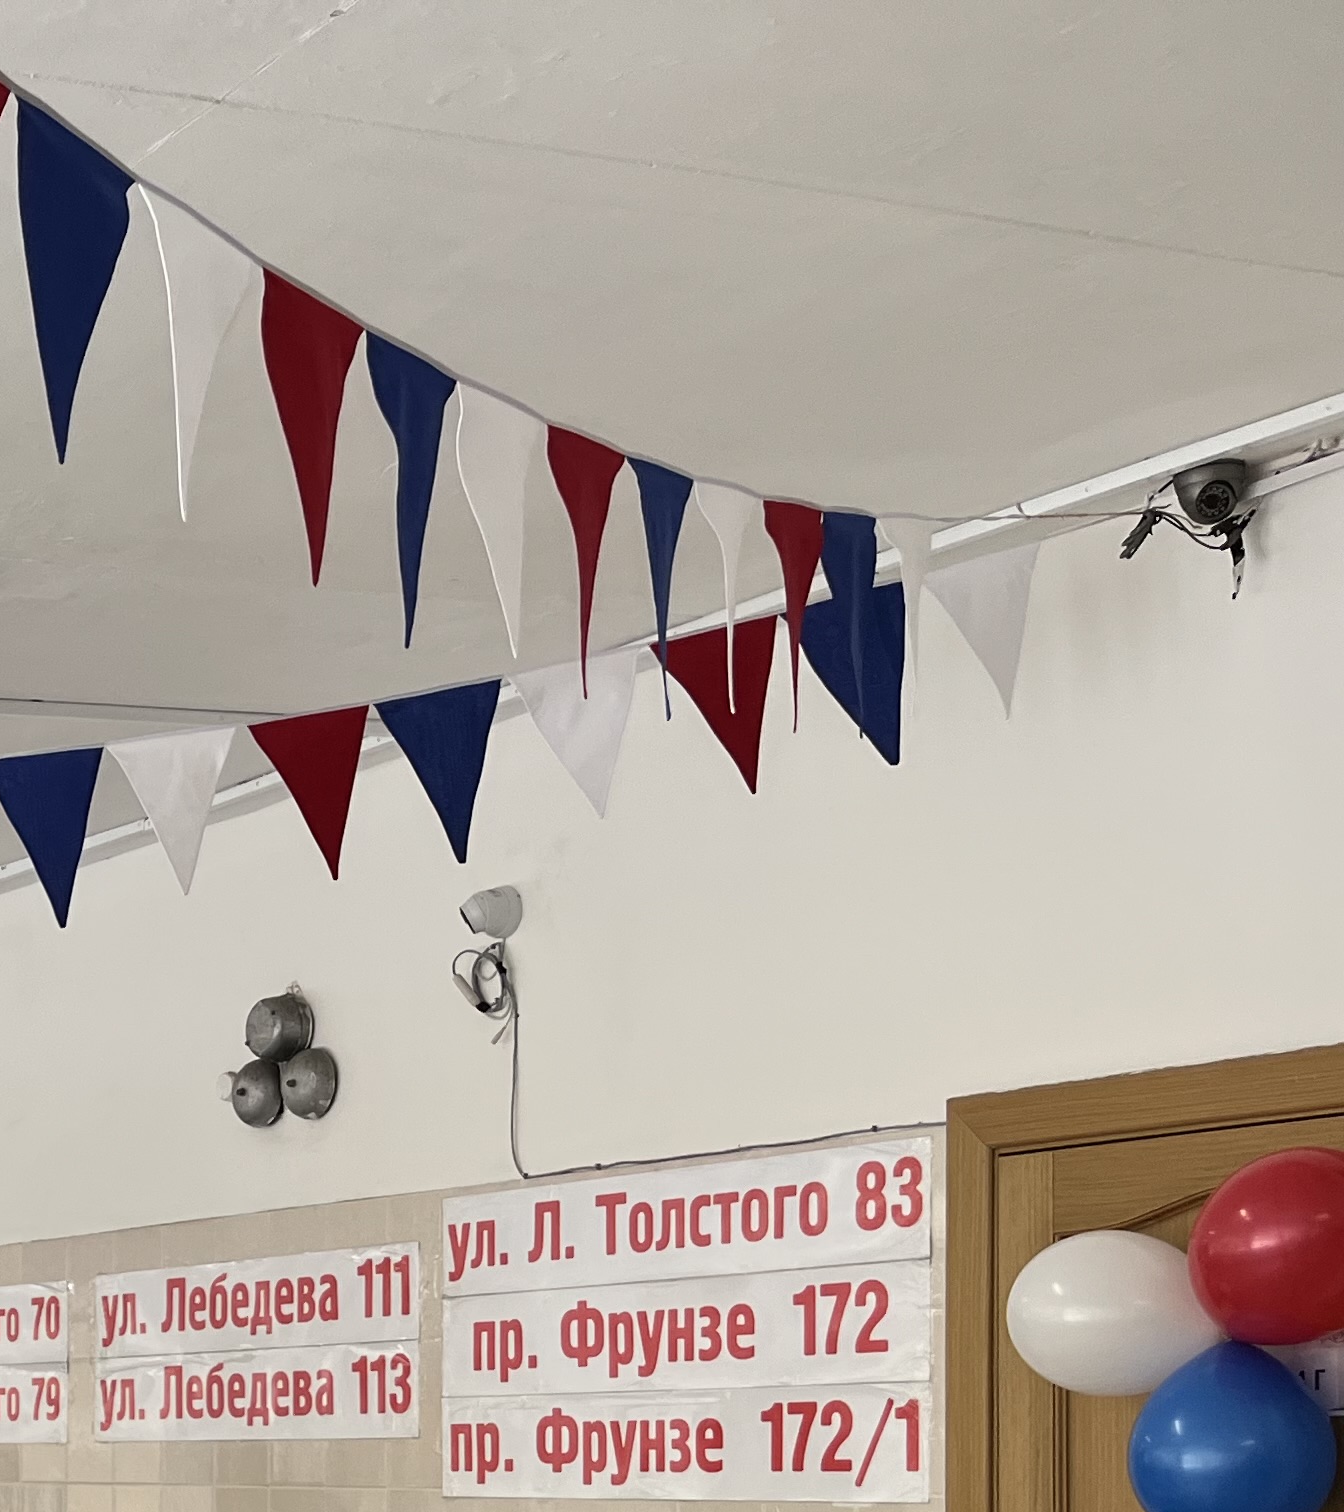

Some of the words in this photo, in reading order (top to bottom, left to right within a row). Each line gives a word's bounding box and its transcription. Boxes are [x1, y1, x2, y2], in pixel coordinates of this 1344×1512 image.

[448, 1219, 509, 1283] ул.
[528, 1200, 575, 1262] Л.
[595, 1180, 829, 1256] Толстого
[856, 1155, 924, 1232] 83
[32, 1296, 61, 1341] 70
[101, 1292, 147, 1348] ул.
[161, 1273, 340, 1336] Лебедева
[357, 1254, 412, 1319] 111
[473, 1319, 539, 1383] пр.
[560, 1300, 757, 1379] Фрунзе
[792, 1279, 890, 1357] 172
[32, 1376, 61, 1421] 79
[100, 1377, 147, 1432] ул.
[159, 1362, 335, 1427] Лебедева
[351, 1352, 413, 1415] 113
[450, 1423, 515, 1486] пр.
[536, 1408, 725, 1487] Фрунзе
[760, 1398, 922, 1488] 172/1
